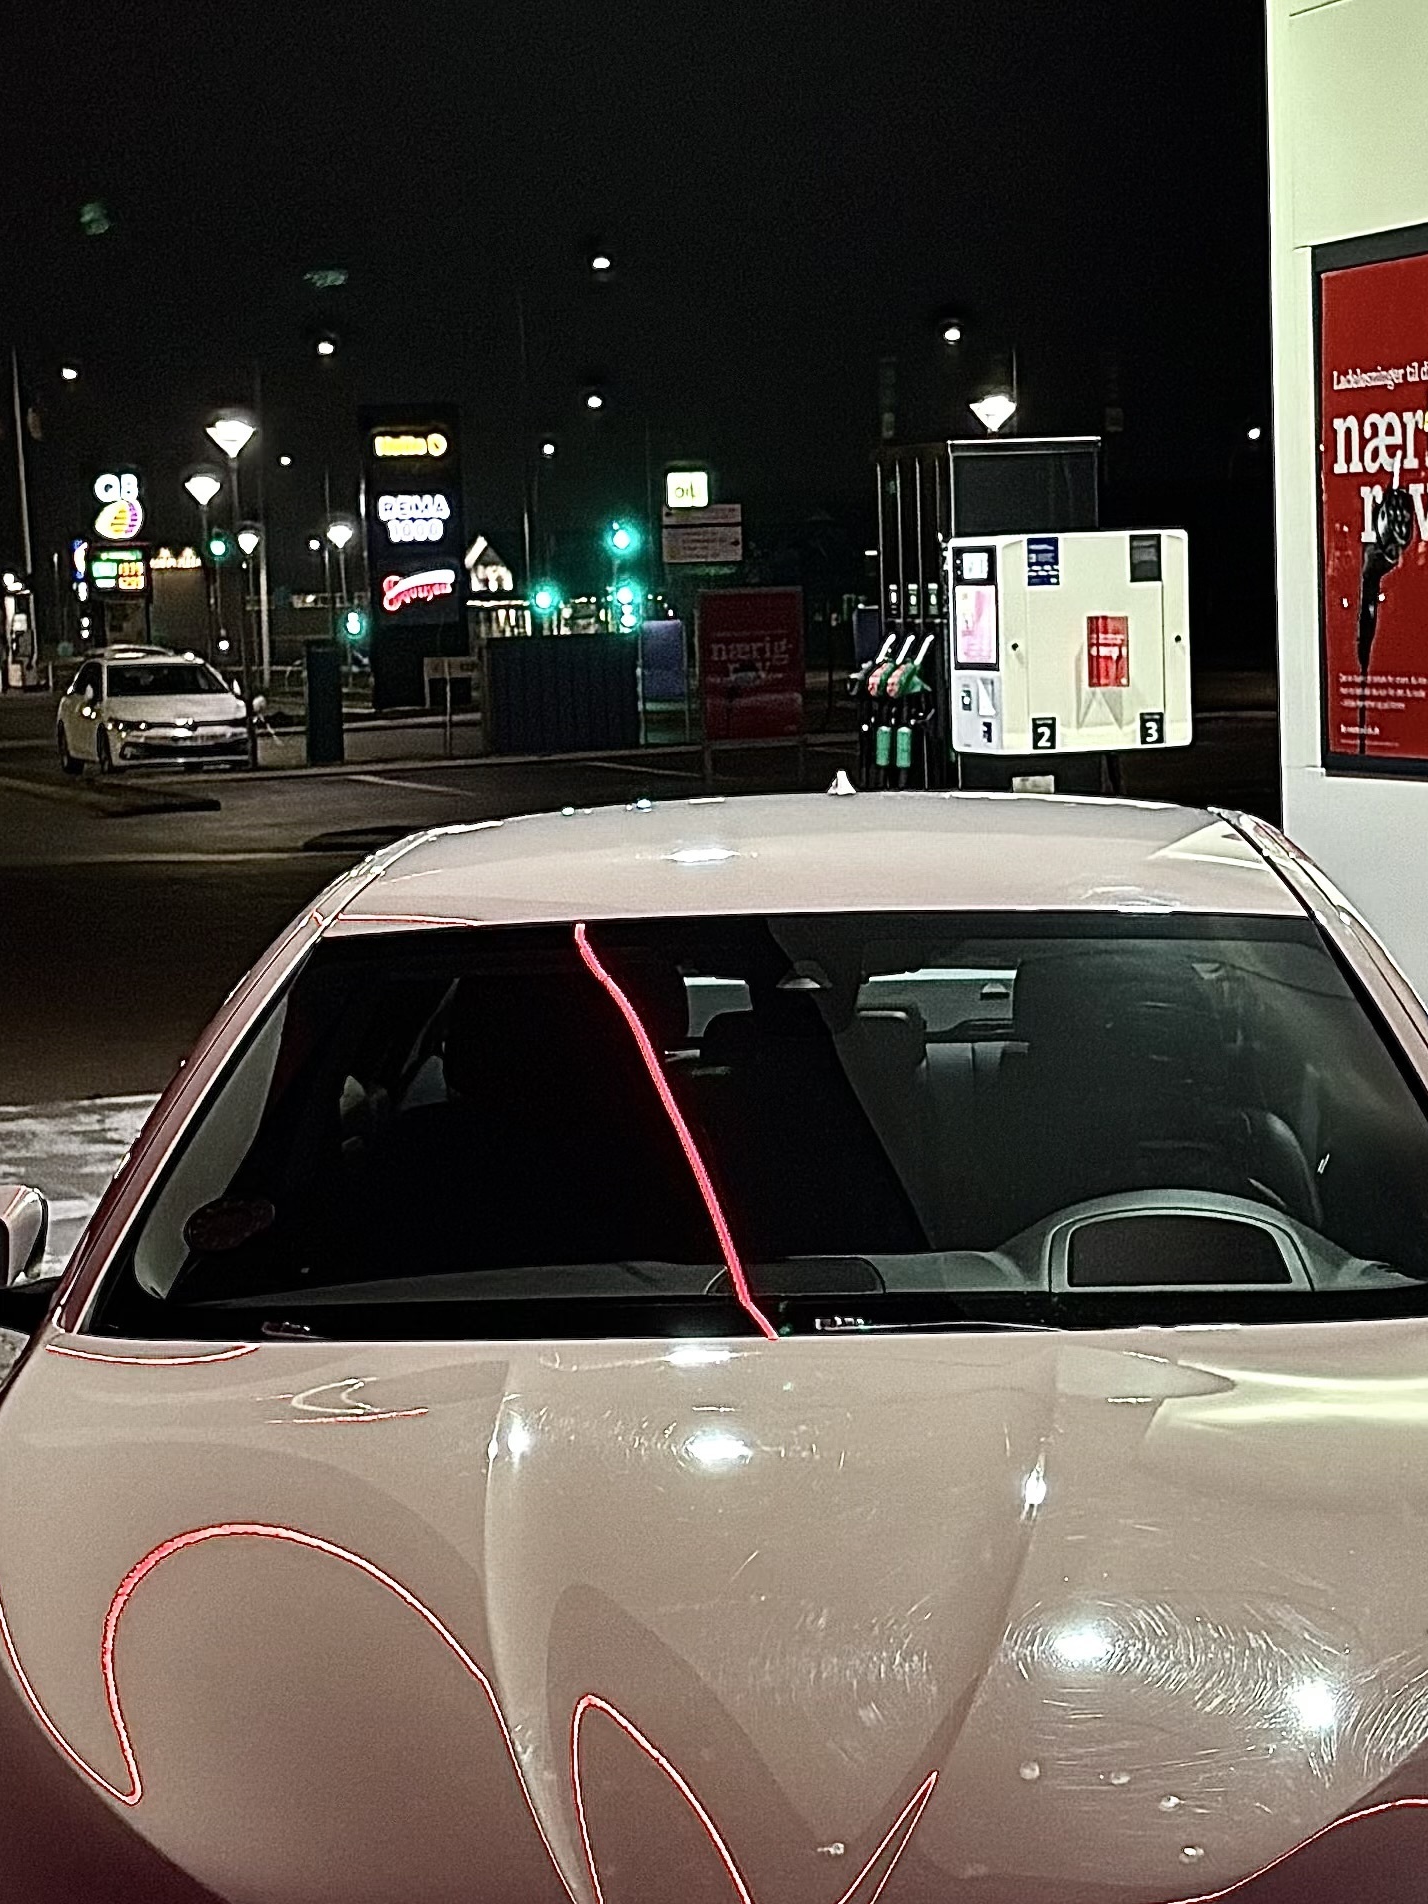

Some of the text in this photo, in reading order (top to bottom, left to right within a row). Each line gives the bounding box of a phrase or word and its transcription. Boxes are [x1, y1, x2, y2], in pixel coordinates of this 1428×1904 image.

[1406, 361, 1420, 382] til
[378, 494, 451, 521] REMA
[387, 517, 444, 542] 1000
[1037, 728, 1053, 748] 2
[1144, 720, 1160, 743] 3
